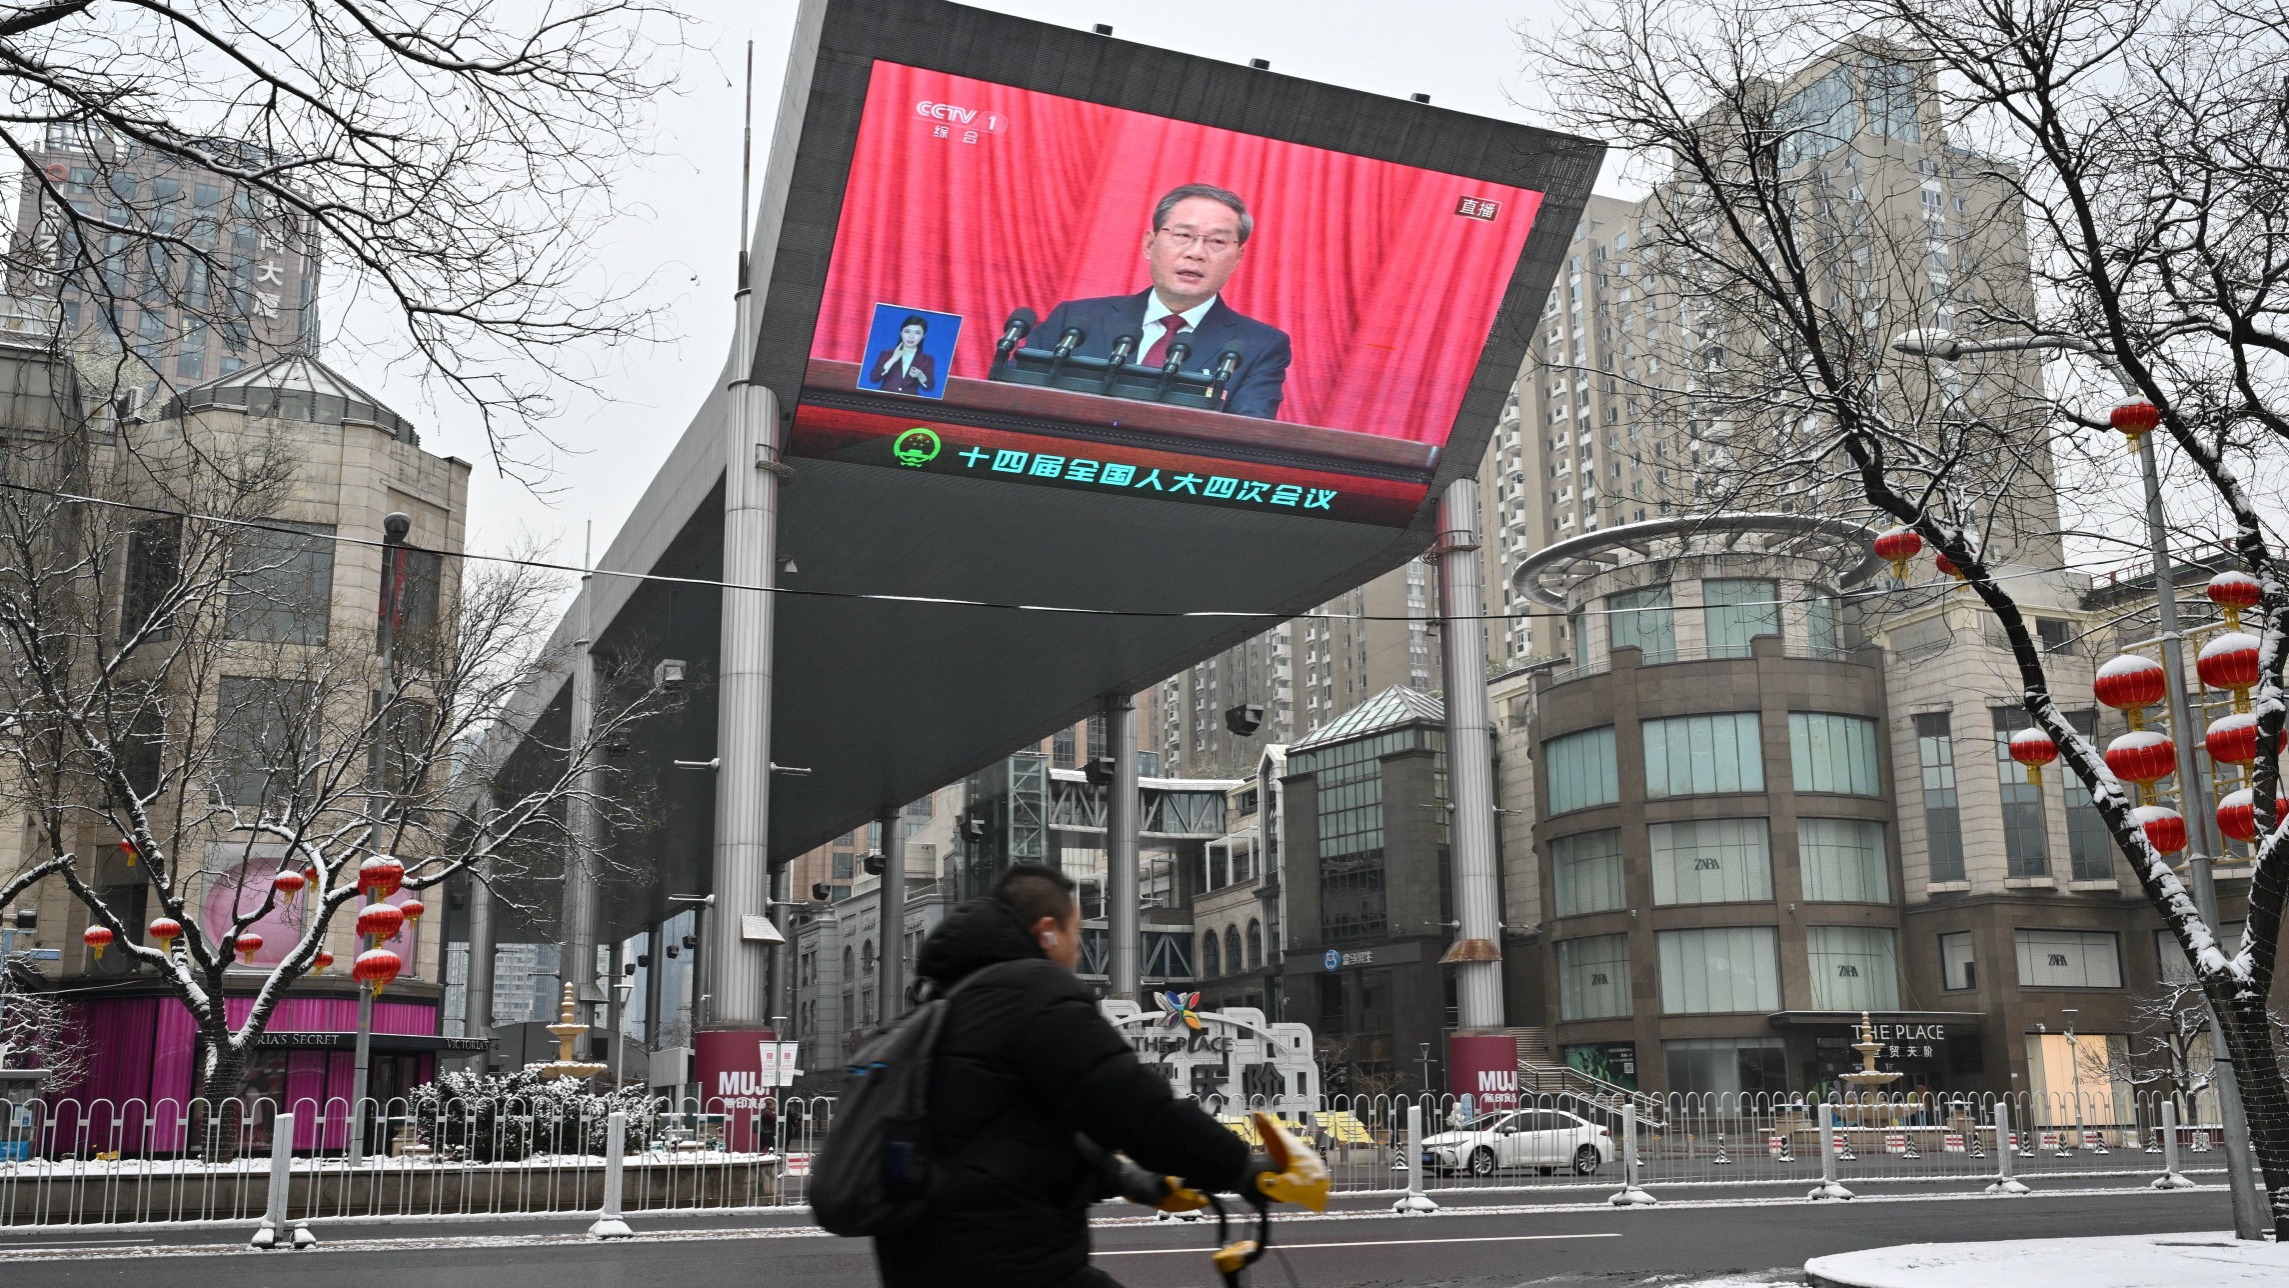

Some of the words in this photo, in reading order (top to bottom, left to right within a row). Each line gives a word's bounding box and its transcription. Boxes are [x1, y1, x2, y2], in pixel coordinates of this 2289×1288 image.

[916, 101, 978, 124] CCTV
[988, 115, 997, 131] 1
[933, 125, 979, 145] 综合
[1459, 199, 1497, 218] 直播
[958, 446, 1338, 511] 十四届全国人大四次会议
[1694, 858, 1720, 870] ZARA
[2048, 954, 2068, 966] ZARA
[257, 1034, 288, 1045] RIA'S
[292, 1033, 340, 1045] SECRET
[1851, 1025, 1890, 1040] THE
[1895, 1025, 1945, 1040] PLACE
[1131, 1036, 1170, 1052] THE
[1177, 1036, 1233, 1053] PLACE
[1478, 1070, 1518, 1092] MUJI
